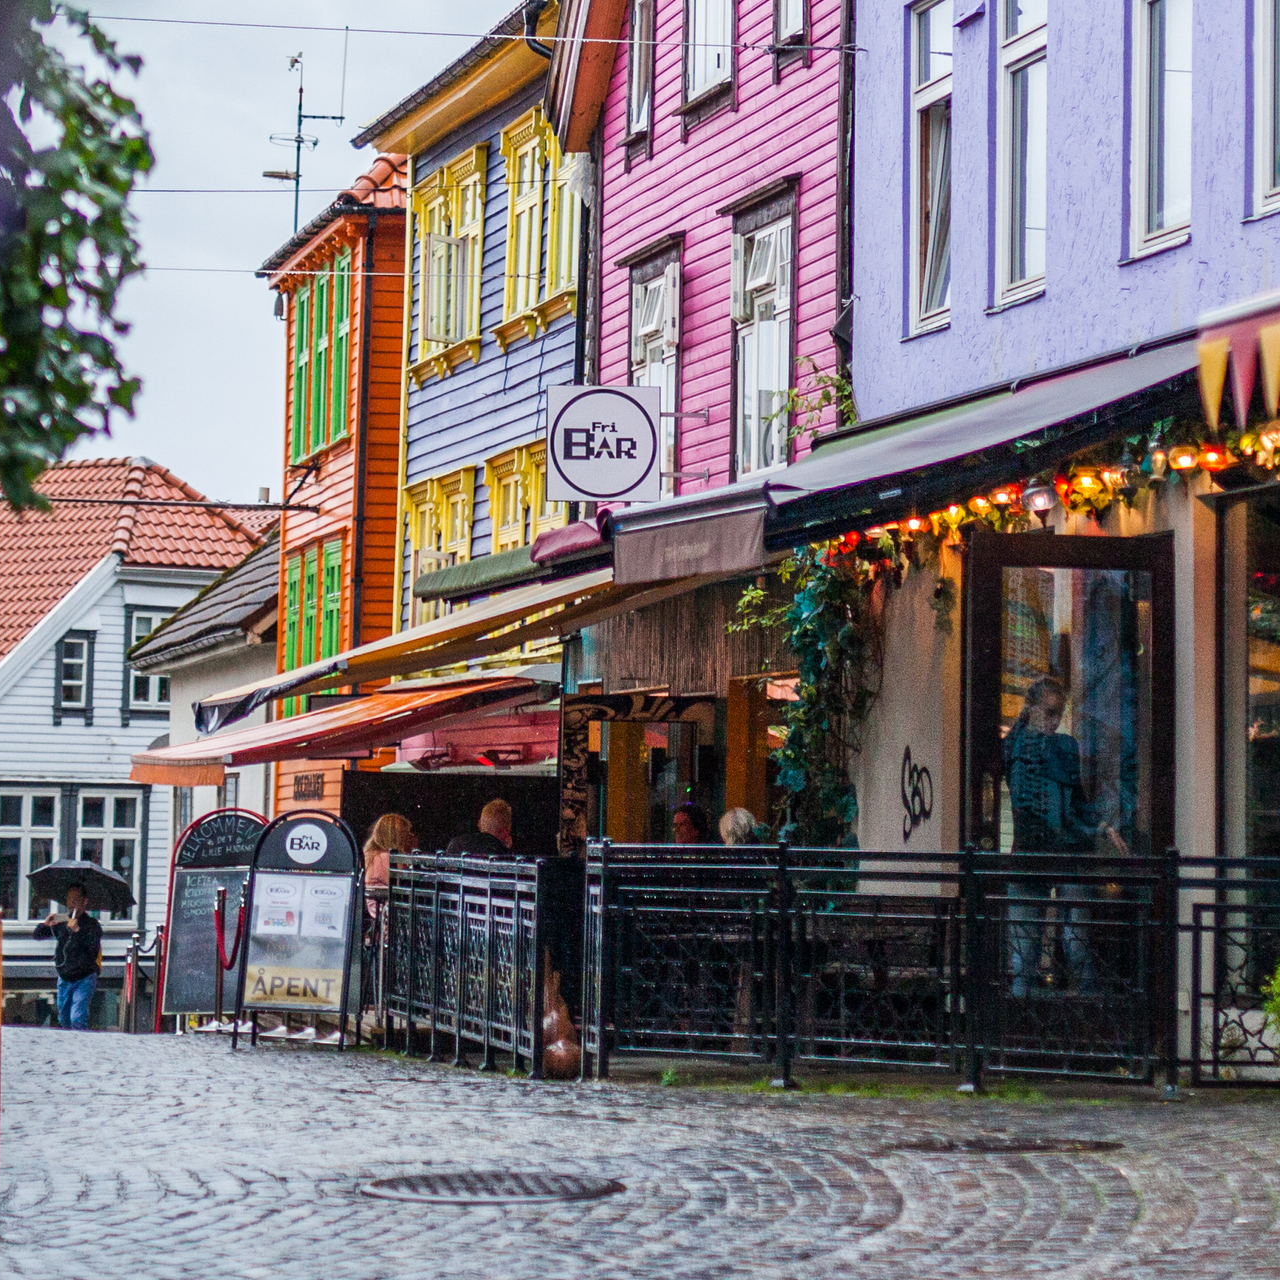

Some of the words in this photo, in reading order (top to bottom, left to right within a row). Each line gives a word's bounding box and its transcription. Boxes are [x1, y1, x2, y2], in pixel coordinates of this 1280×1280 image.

[592, 422, 618, 433] Fri
[563, 428, 637, 461] BAR
[180, 816, 263, 865] VELKOMMEN
[289, 837, 321, 851] BAR
[251, 968, 336, 999] ÅPENT
